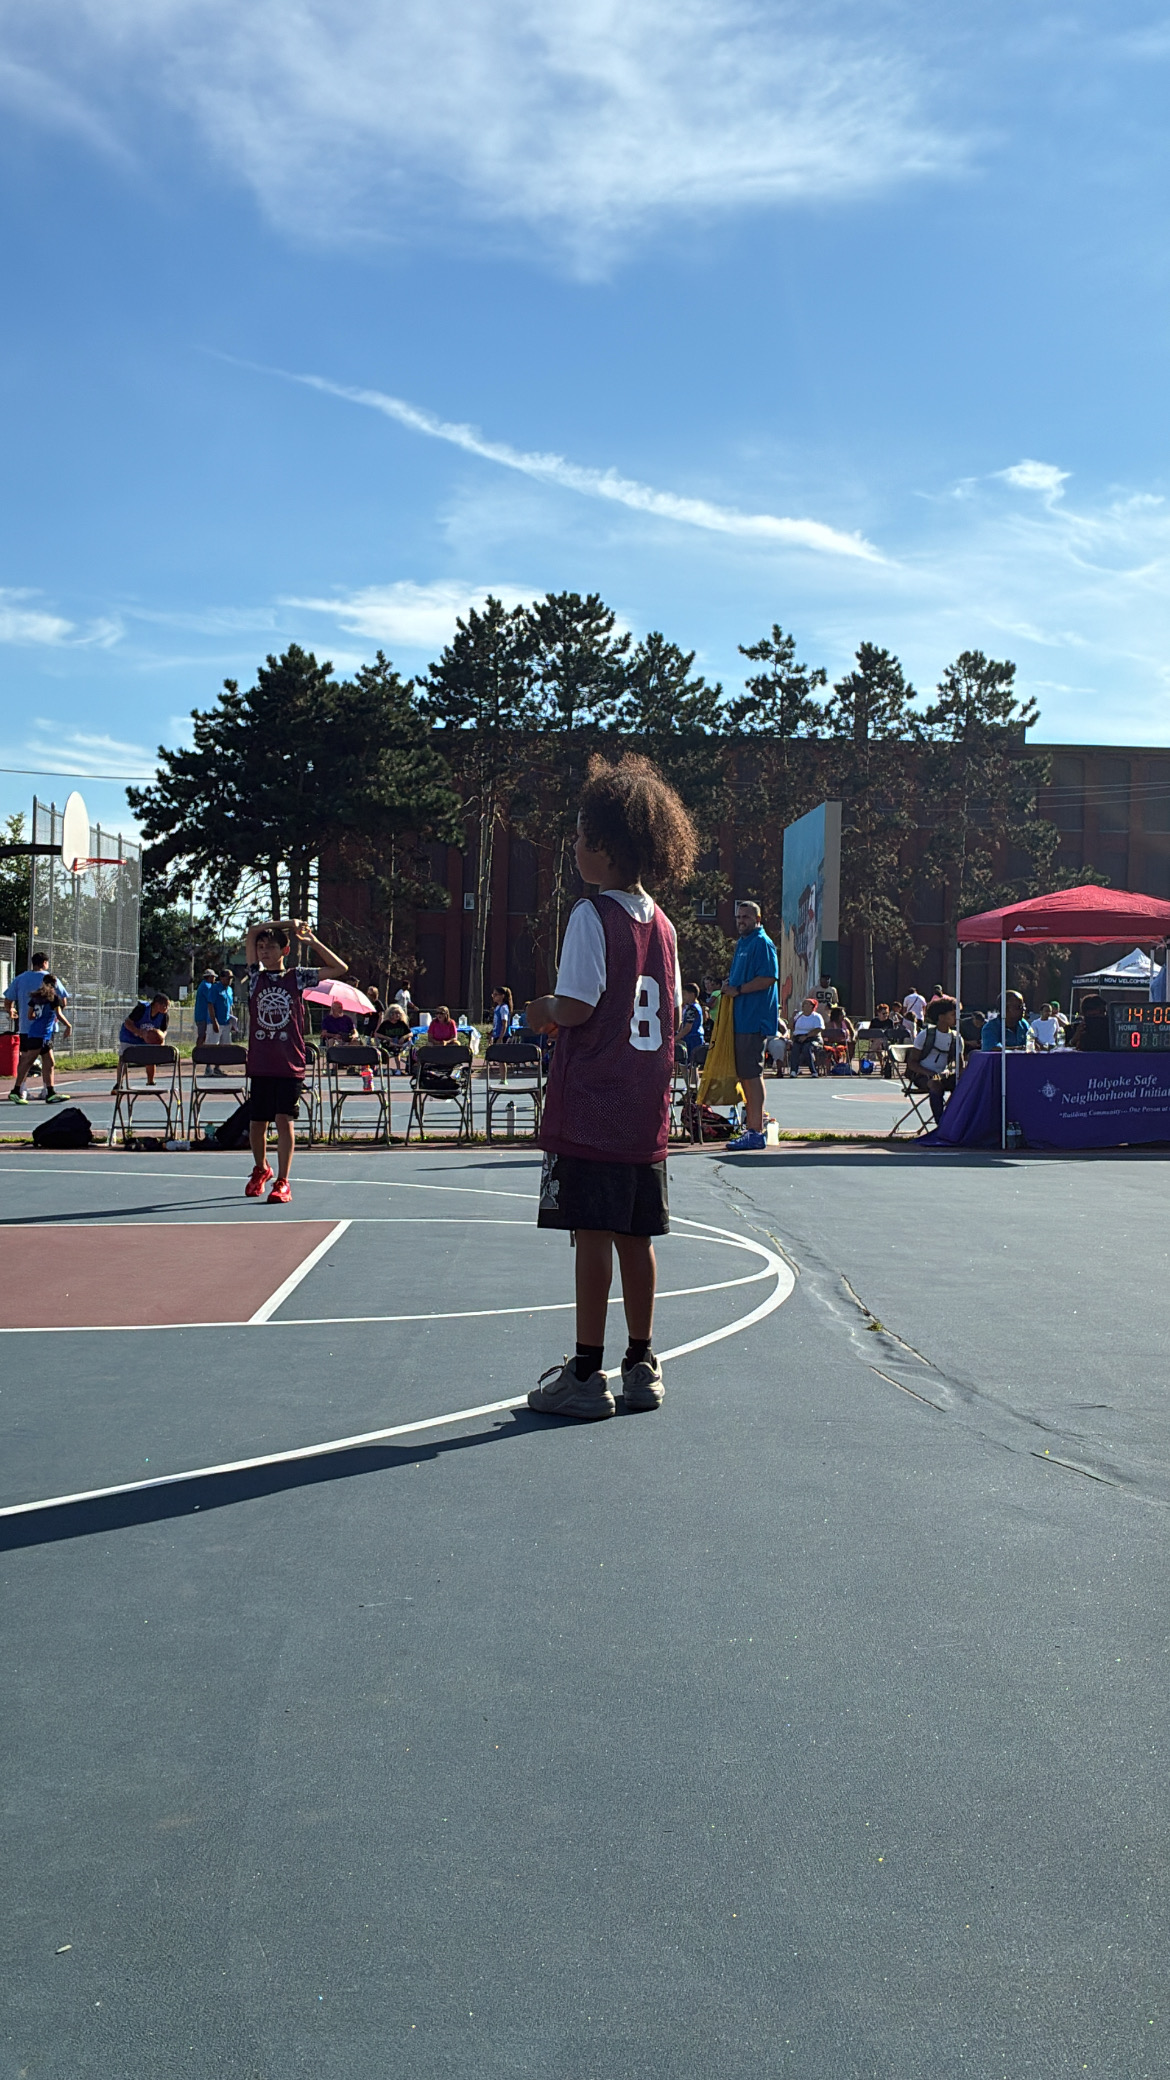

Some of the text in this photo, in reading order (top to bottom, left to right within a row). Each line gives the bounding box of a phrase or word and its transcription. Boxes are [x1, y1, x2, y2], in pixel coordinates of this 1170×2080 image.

[258, 986, 292, 999] HOLYOKE
[629, 974, 663, 1052] 8
[1131, 1031, 1141, 1048] 0
[1088, 1074, 1158, 1090] Holyoke Safe
[1061, 1088, 1136, 1104] Neighborhood
